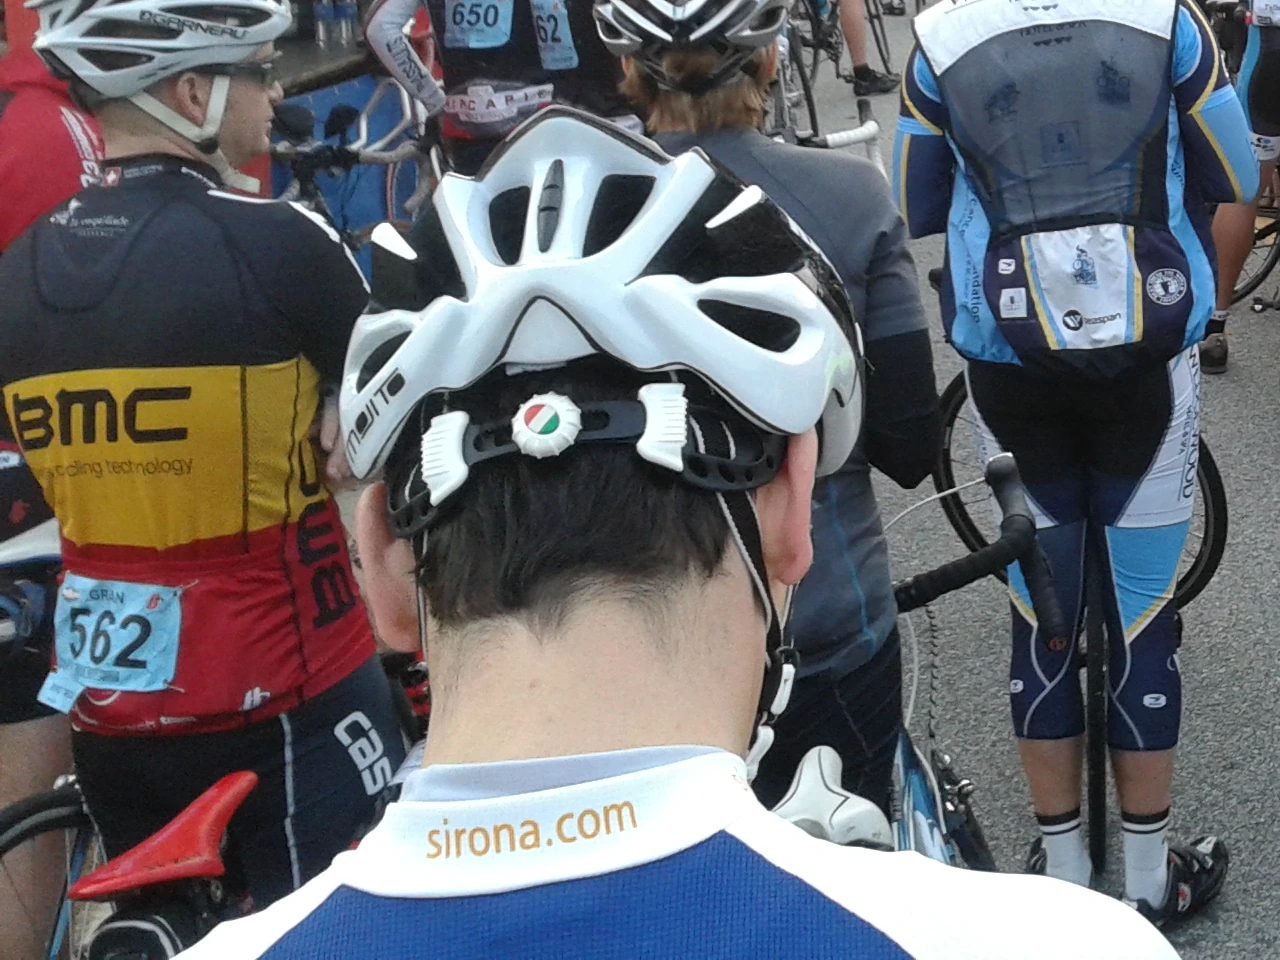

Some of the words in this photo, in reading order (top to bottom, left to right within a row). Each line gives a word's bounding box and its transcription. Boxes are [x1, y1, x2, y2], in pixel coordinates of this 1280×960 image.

[452, 2, 499, 27] 650
[13, 386, 191, 452] BMC
[346, 366, 406, 464] MOJITO
[88, 589, 125, 604] GRAN
[69, 606, 152, 669] 562
[426, 800, 638, 859] sirona.com
